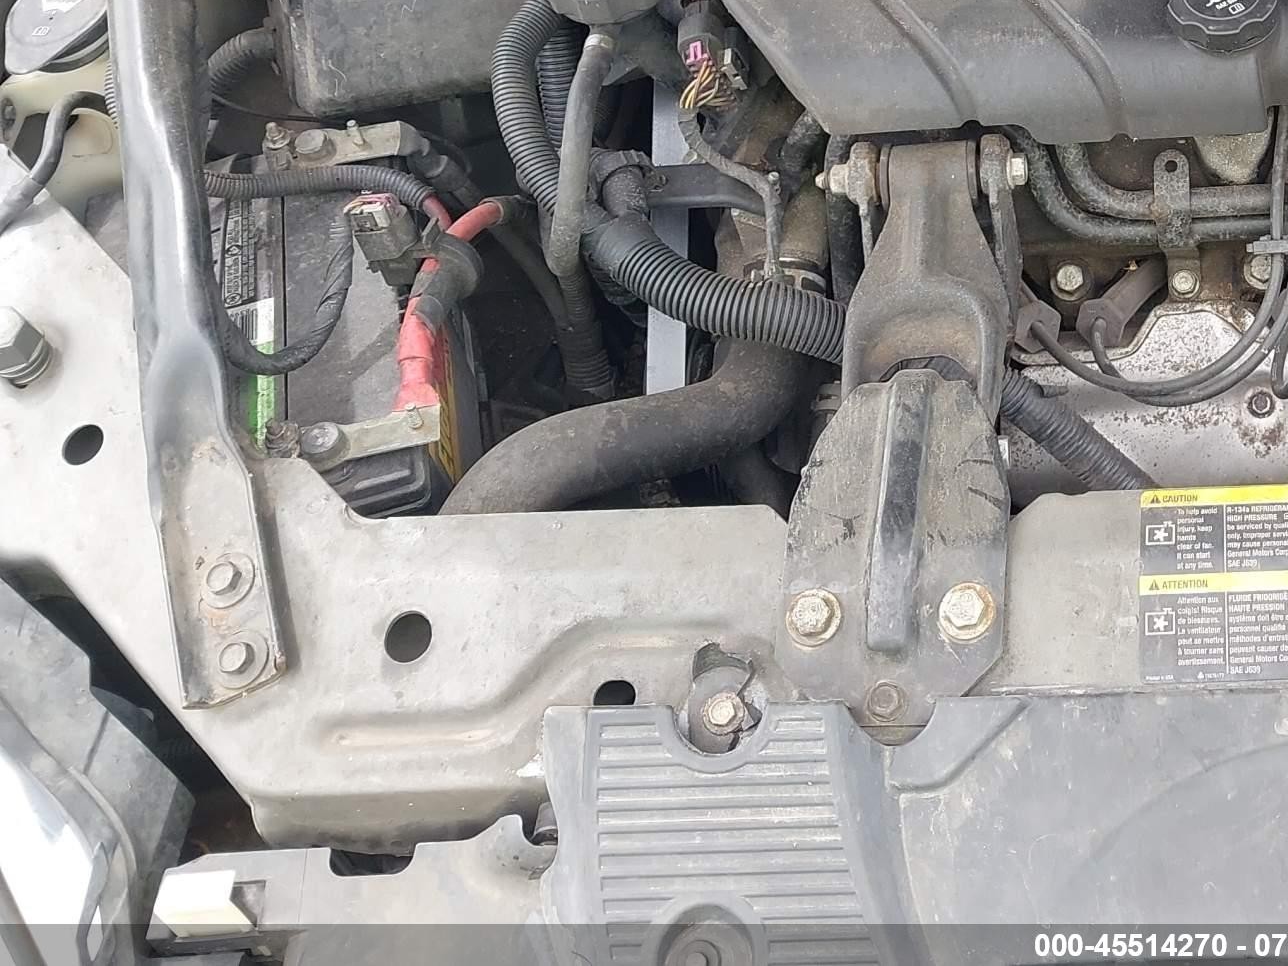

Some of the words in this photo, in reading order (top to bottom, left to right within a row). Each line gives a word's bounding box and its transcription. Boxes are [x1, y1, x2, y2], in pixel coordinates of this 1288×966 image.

[1162, 494, 1198, 503] CAUTION
[1177, 516, 1204, 524] personal
[1226, 514, 1242, 522] HIGH
[1243, 513, 1278, 521] PRESSURE
[1252, 549, 1274, 557] Motors
[1162, 579, 1208, 589] ATTENTION
